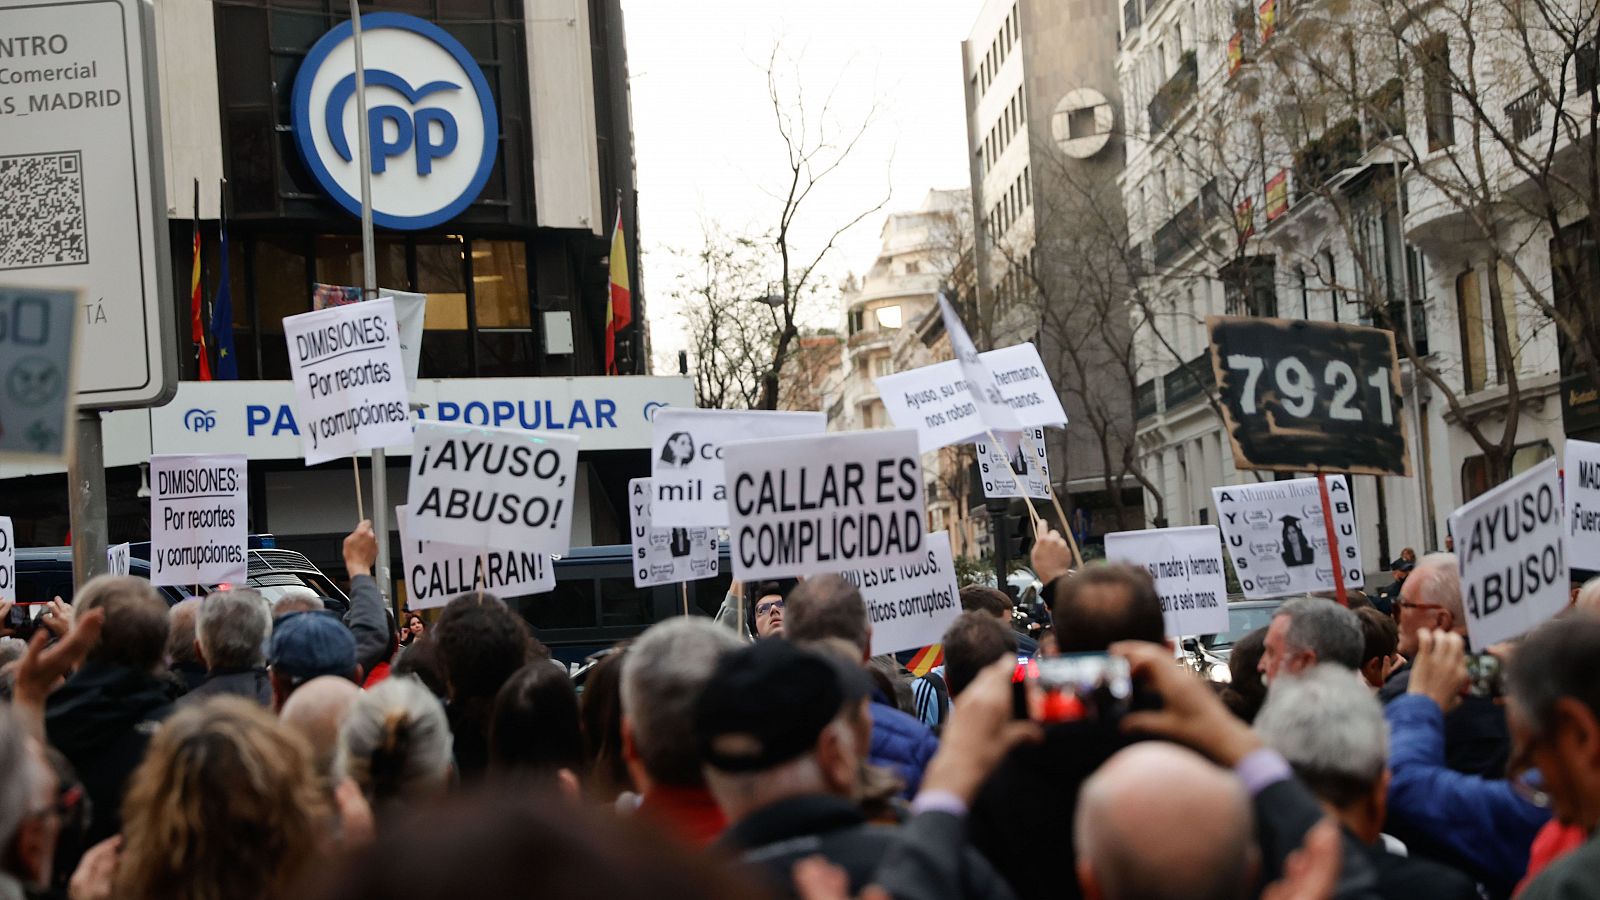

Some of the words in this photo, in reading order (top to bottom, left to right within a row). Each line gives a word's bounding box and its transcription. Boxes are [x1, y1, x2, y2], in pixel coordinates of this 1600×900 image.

[0, 60, 97, 84] Comercial
[0, 89, 121, 116] S_MADRID
[296, 316, 390, 362] DIMISIONES:
[309, 372, 332, 399] Por
[335, 358, 391, 391] recortes
[940, 383, 955, 397] su
[1227, 354, 1393, 427] 7921
[308, 420, 318, 450] y
[320, 398, 409, 439] corrupciones.
[925, 412, 946, 428] nos
[945, 402, 977, 422] roban
[158, 467, 239, 495] DIMISIONES:
[417, 439, 567, 488] ¡AYUSO,
[659, 480, 703, 501] mil
[734, 461, 864, 517] CALLAR
[876, 457, 918, 505] ES
[164, 506, 185, 531] Por
[188, 504, 235, 528] recortes
[415, 486, 564, 530] ABUSO!
[739, 509, 922, 569] COMPLICIDAD
[1459, 483, 1560, 577] ¡AYUSO,
[157, 549, 164, 573] y
[167, 539, 245, 570] corrupciones.
[411, 550, 543, 600] CALLARAN!
[1159, 555, 1184, 579] madre
[1184, 560, 1190, 581] y
[1468, 537, 1564, 620] ABUSO!
[867, 599, 897, 622] íticos
[899, 585, 956, 618] corruptos!
[1173, 595, 1179, 611] a
[1179, 588, 1195, 610] seis
